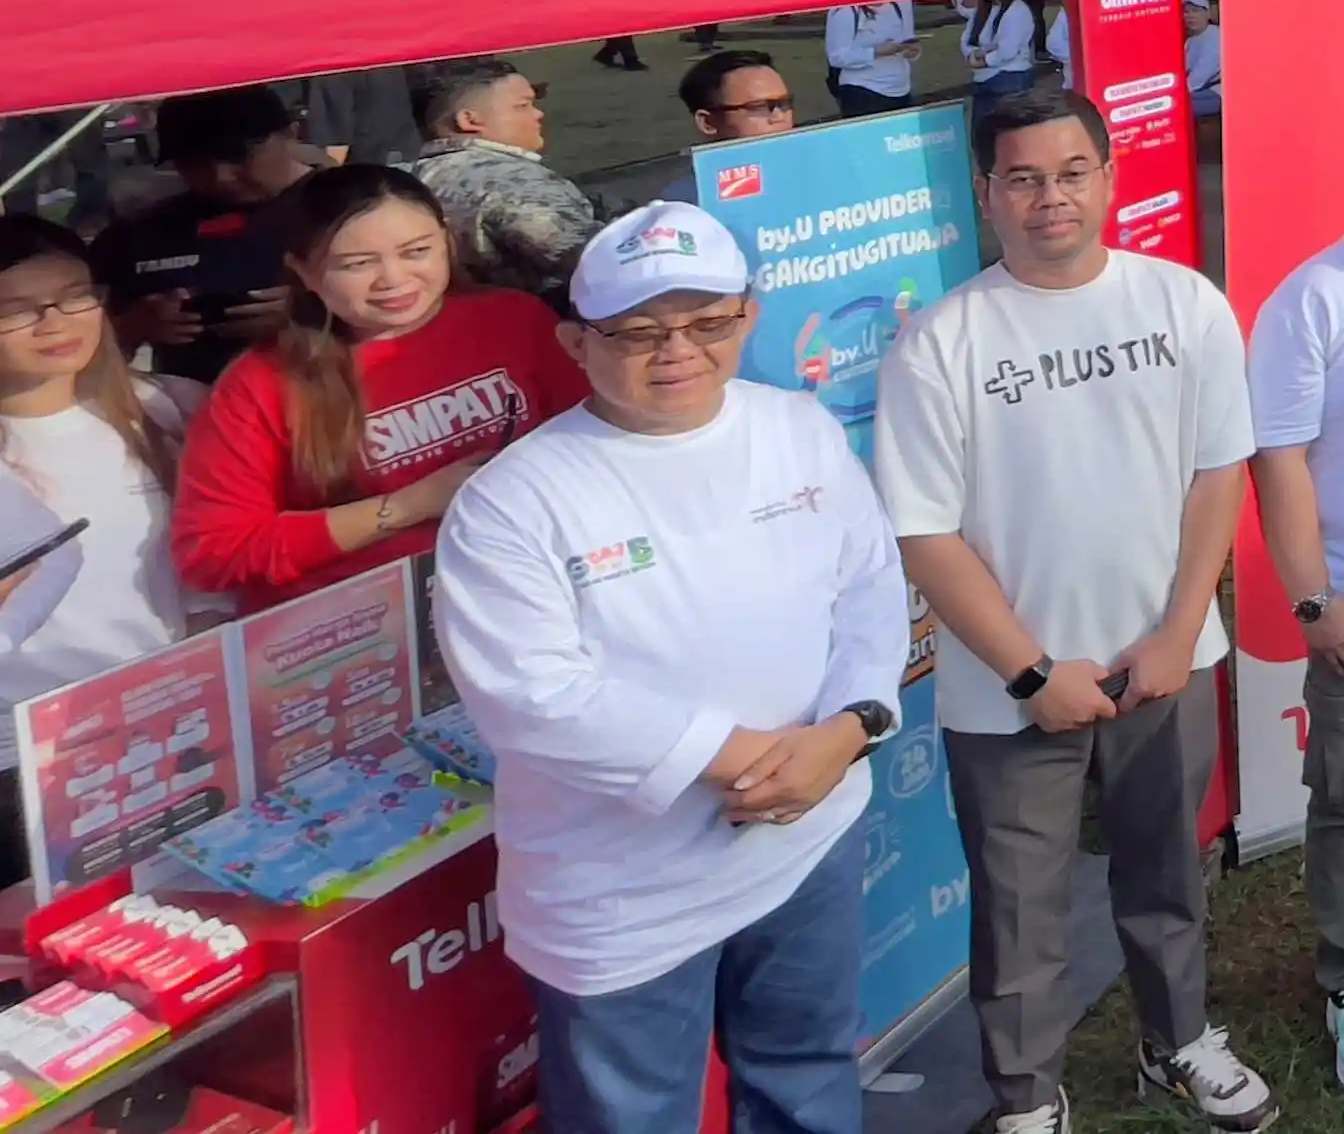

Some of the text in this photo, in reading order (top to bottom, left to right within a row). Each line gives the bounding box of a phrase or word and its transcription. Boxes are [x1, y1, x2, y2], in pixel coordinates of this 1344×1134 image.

[884, 129, 956, 154] Telkomsel
[757, 215, 813, 252] by.U
[819, 186, 932, 236] PROVIDER
[1038, 331, 1177, 391] PLUS TIK
